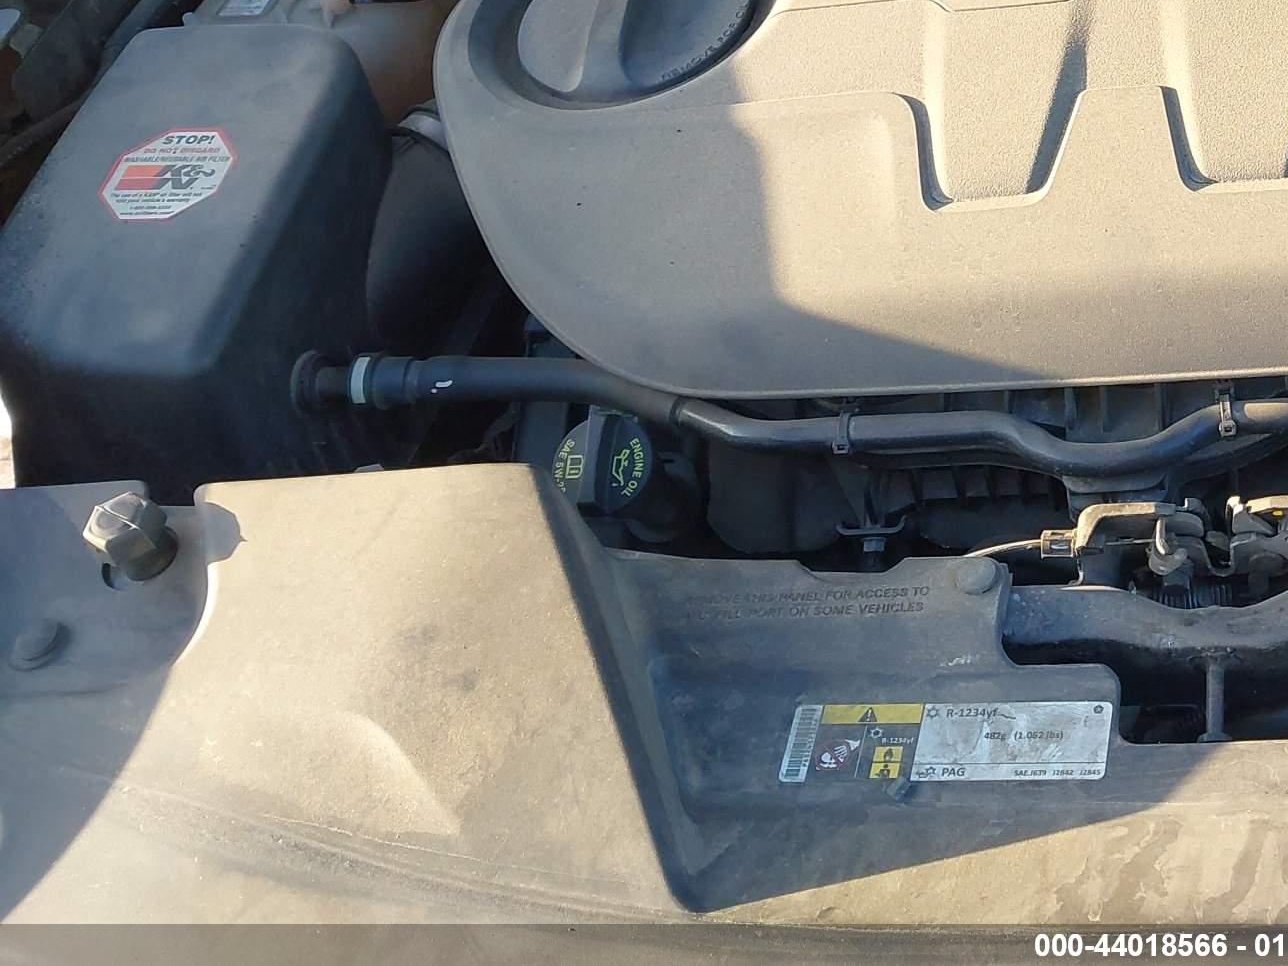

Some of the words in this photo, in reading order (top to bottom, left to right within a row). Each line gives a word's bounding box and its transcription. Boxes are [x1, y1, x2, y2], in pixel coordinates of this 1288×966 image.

[162, 135, 216, 145] STOP!
[158, 147, 181, 155] NOT
[558, 438, 576, 460] SAE
[629, 437, 645, 479] ENGINE
[620, 479, 638, 497] OIL
[778, 591, 820, 603] PANEL
[825, 590, 851, 602] FOR
[855, 587, 909, 600] ACCESS
[912, 585, 931, 597] TO
[788, 606, 809, 618] ON
[813, 604, 856, 617] SOME
[858, 601, 925, 614] VEHICLES
[946, 707, 999, 719] R-1234yf
[941, 767, 967, 777] PAG
